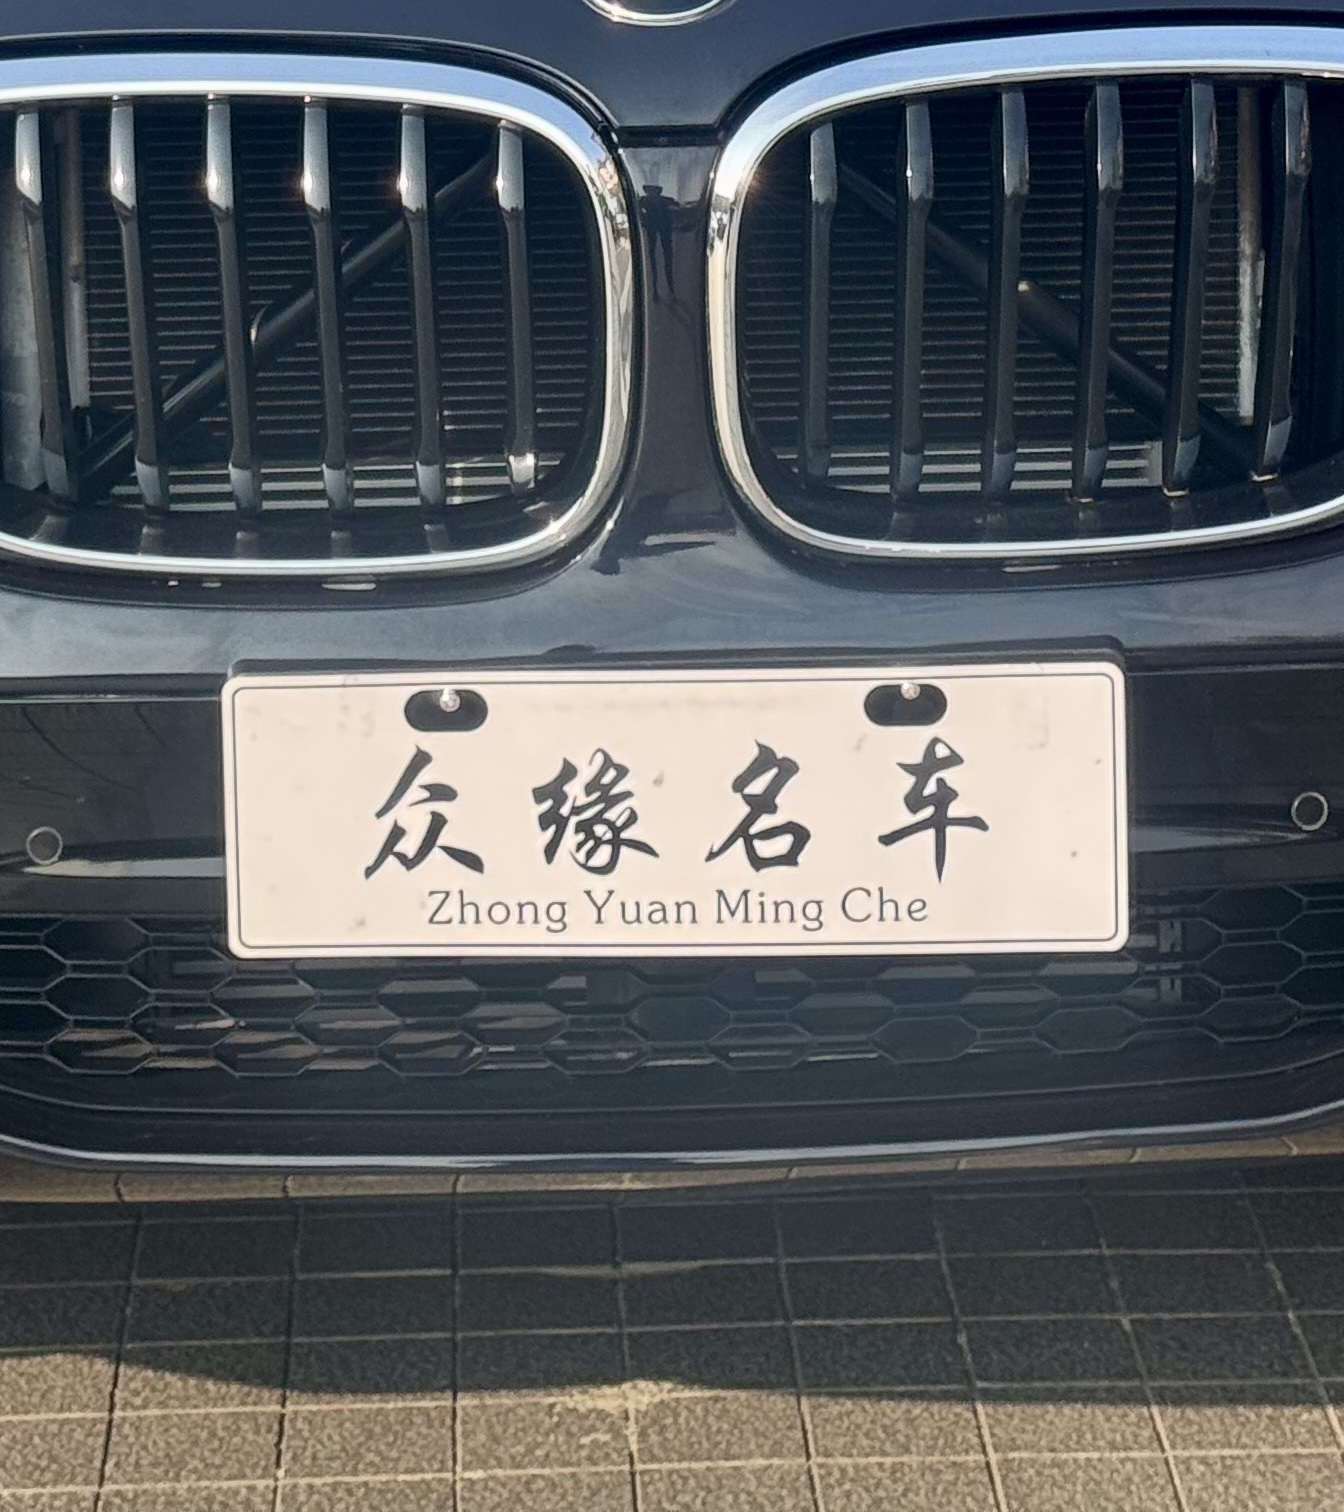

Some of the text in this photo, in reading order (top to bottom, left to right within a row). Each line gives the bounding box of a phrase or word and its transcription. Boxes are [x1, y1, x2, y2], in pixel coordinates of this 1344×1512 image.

[364, 737, 990, 883] 众缘名车
[427, 887, 929, 933] Zhong Yuan Ming Che
